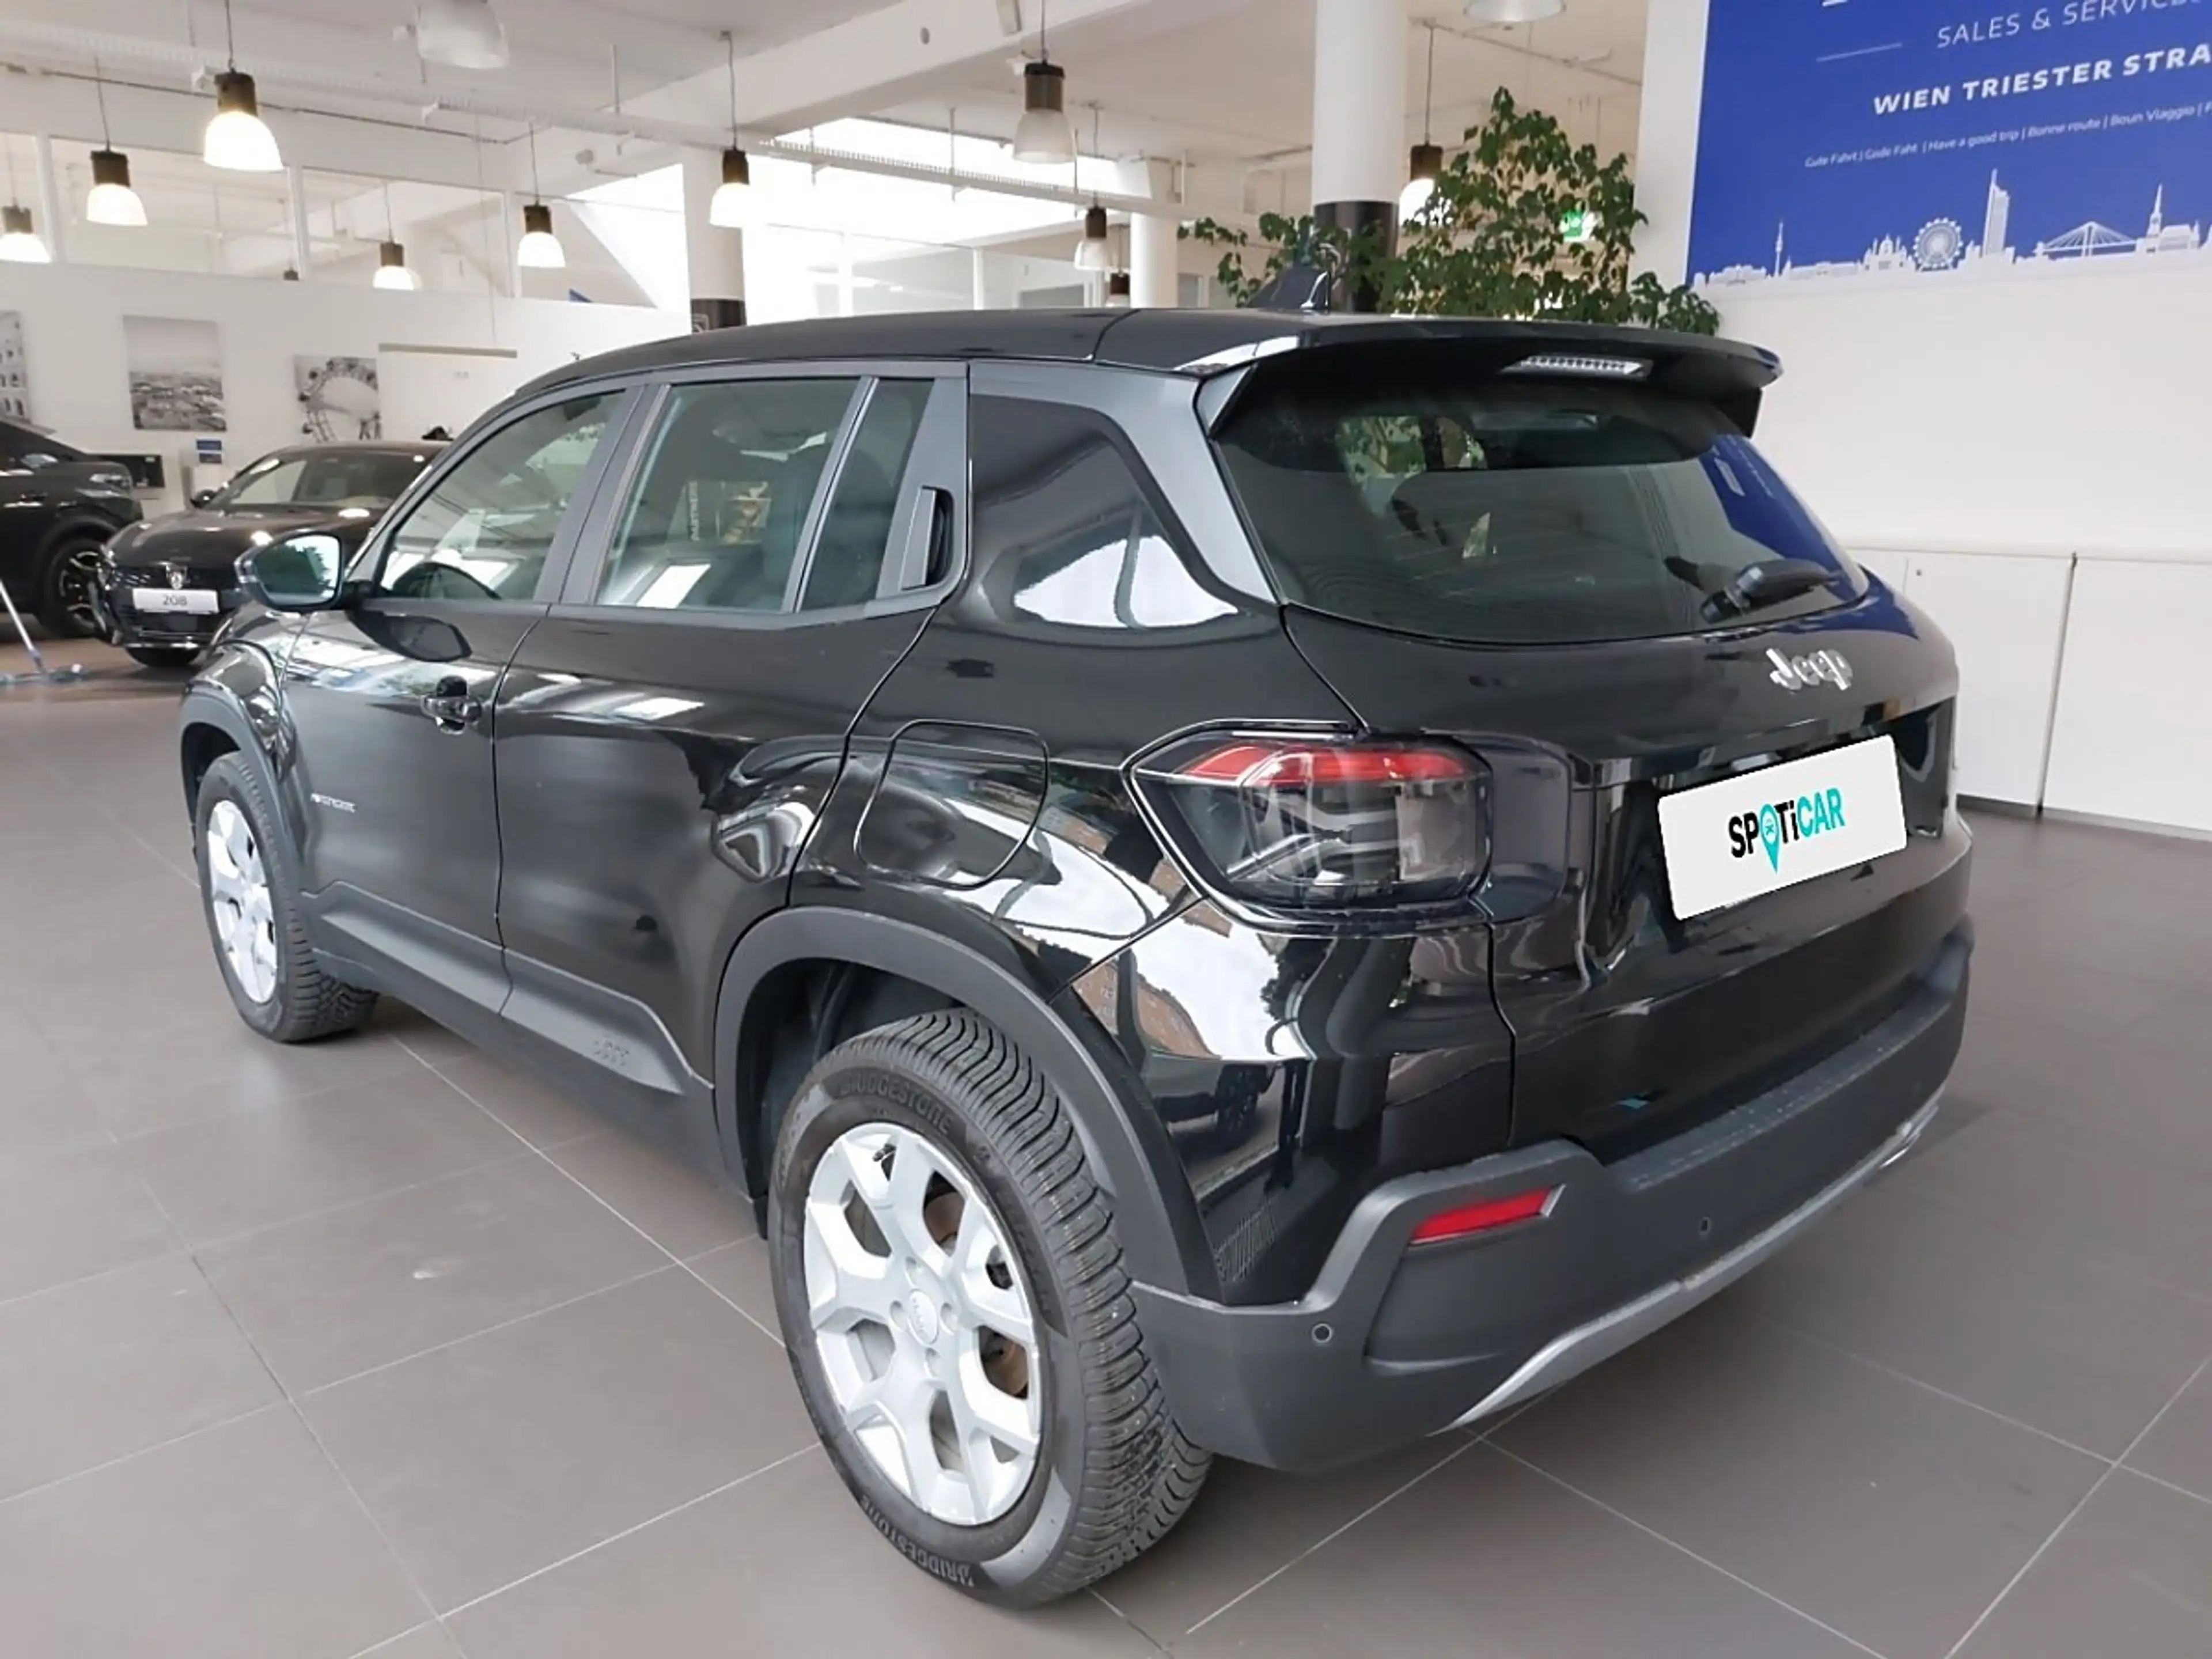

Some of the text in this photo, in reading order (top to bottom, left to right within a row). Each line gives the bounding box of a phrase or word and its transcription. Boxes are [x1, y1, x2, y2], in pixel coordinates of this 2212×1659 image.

[1937, 13, 2020, 49] SALES
[2031, 7, 2051, 31] &
[1874, 85, 1952, 115] WIEN
[1963, 59, 2113, 101] TRIESTER
[1928, 138, 1957, 152] Have
[1958, 137, 1966, 148] a
[1968, 131, 1998, 149] good
[1999, 130, 2019, 143] trip
[2028, 124, 2066, 138] Bonne
[2067, 118, 2101, 132] route
[1766, 647, 1854, 691] Jeep
